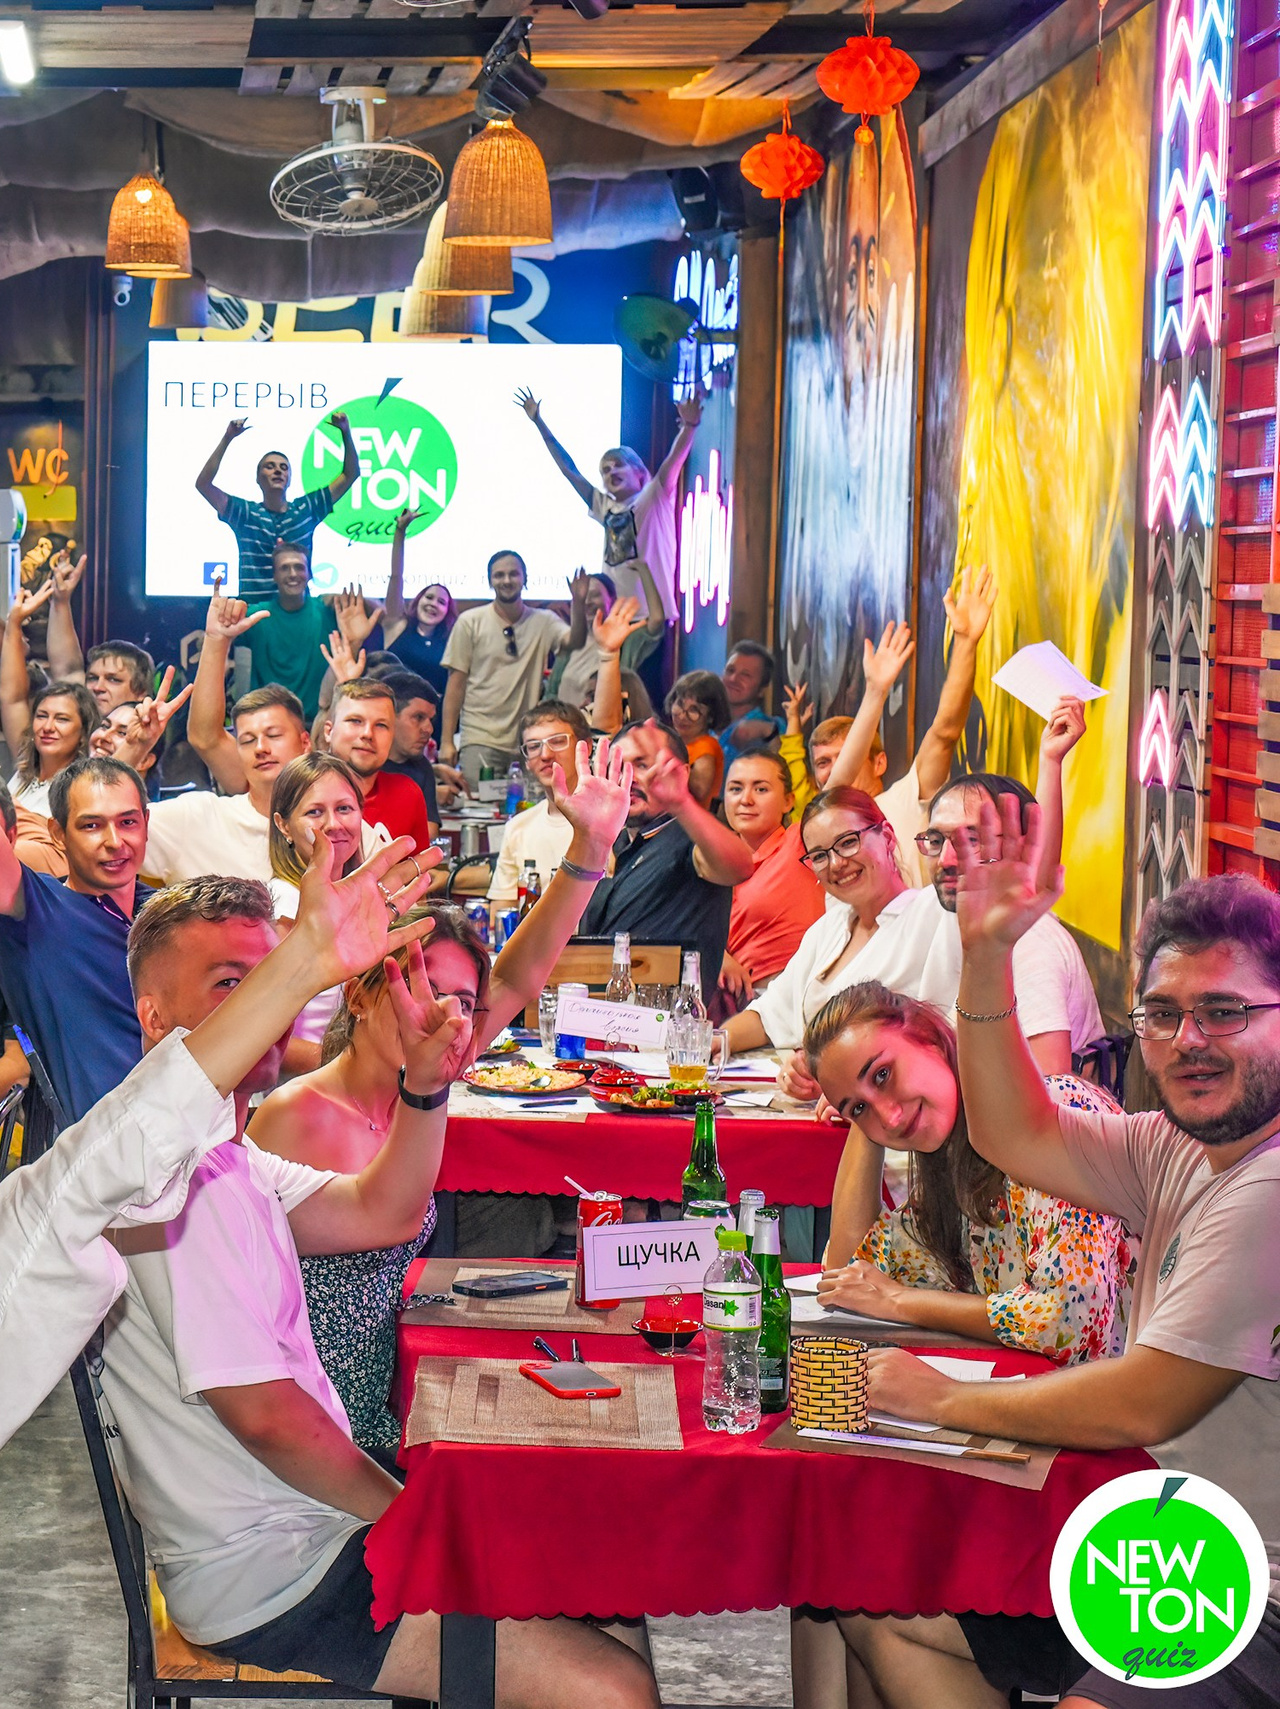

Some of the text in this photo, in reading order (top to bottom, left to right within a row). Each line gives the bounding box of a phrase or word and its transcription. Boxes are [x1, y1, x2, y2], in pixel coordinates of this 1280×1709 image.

[165, 381, 328, 409] ПЕРЕРЫВ
[314, 427, 422, 468] NEW
[7, 448, 69, 484] WC
[346, 517, 401, 548] qui
[618, 1241, 700, 1270] ЩУЧКА
